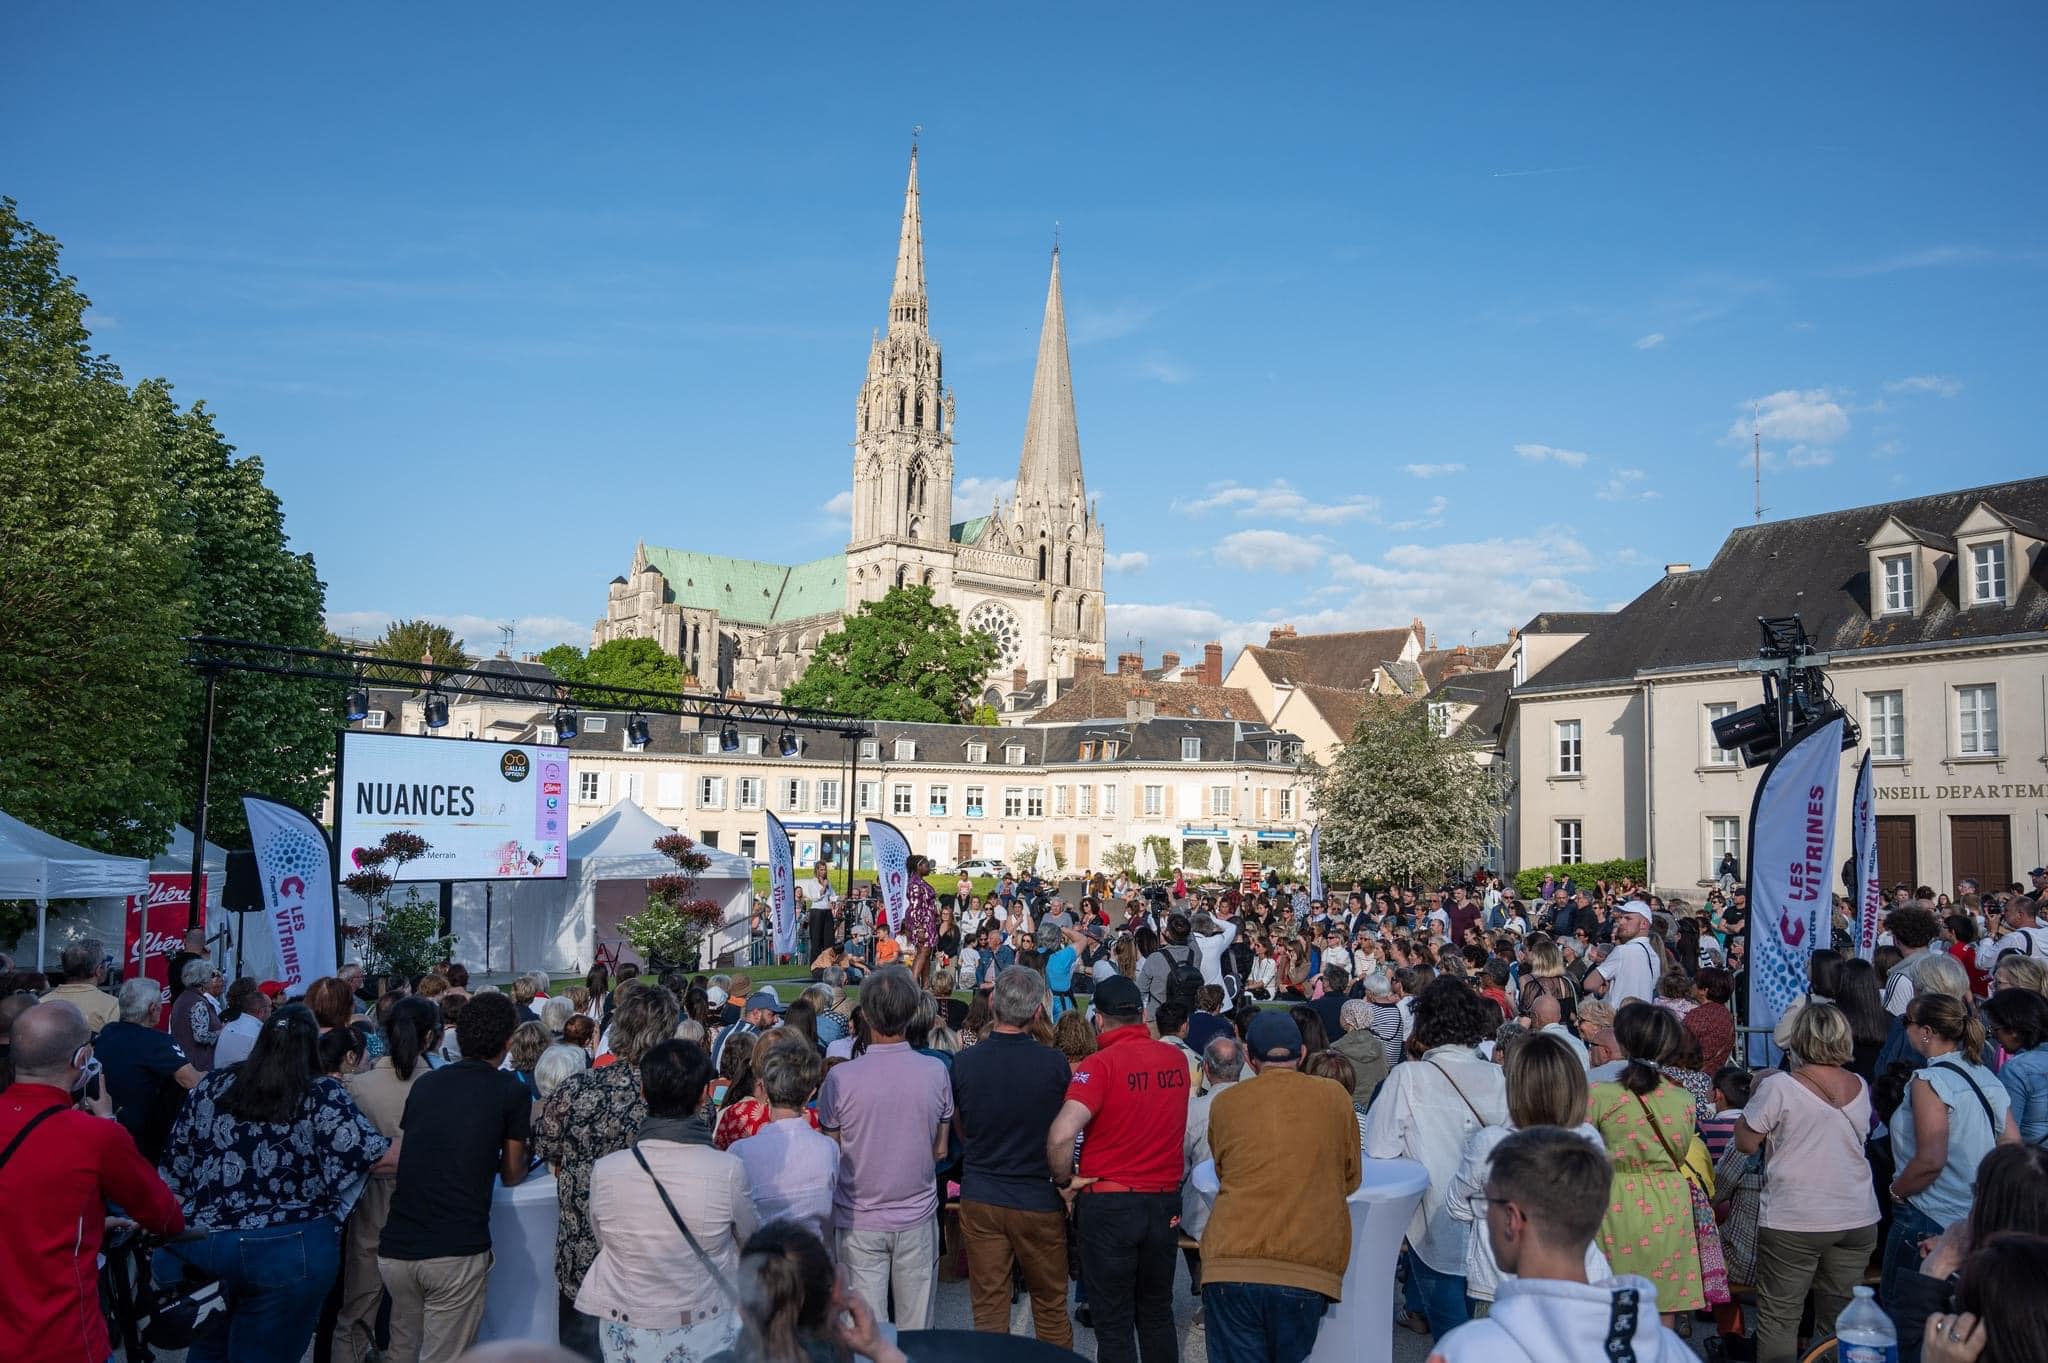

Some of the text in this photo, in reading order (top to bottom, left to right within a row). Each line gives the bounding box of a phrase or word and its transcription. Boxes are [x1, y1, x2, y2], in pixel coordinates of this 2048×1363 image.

[356, 782, 475, 817] NUANCES
[1873, 786, 1930, 800] NSEIL
[1804, 785, 1825, 902] VITRINES
[134, 882, 192, 910] Chéri
[1788, 861, 1803, 901] LES
[291, 906, 305, 932] LES
[889, 894, 900, 932] VITRIN
[276, 909, 302, 985] VITRINES
[1127, 1069, 1184, 1092] 917 023
